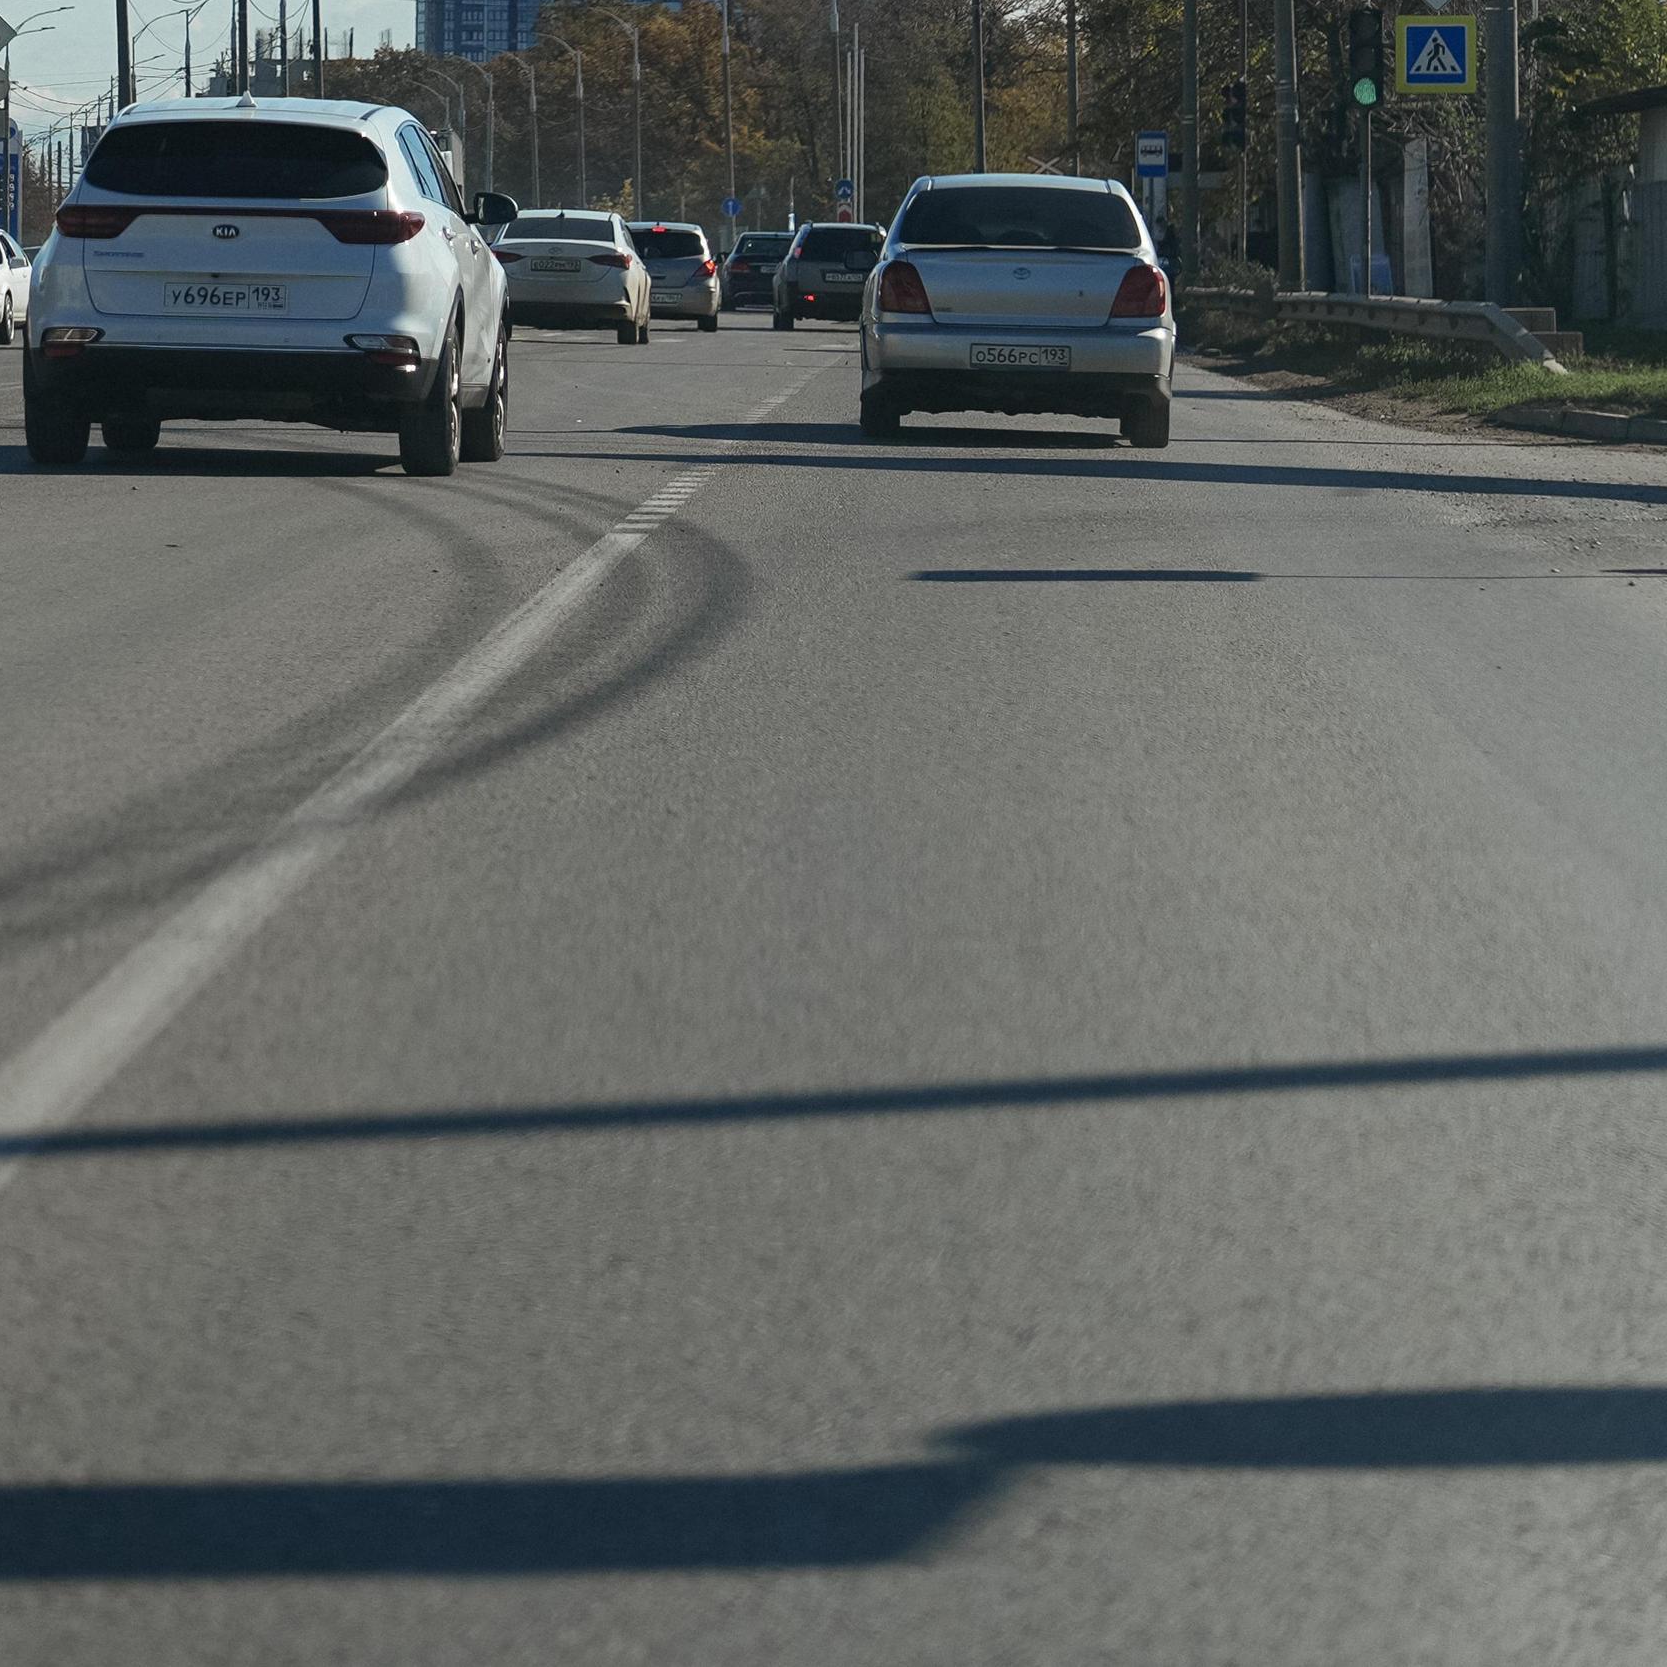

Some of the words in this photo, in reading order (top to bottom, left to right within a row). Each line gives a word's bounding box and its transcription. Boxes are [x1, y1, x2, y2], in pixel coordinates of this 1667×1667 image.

[216, 227, 237, 237] KIA
[252, 287, 281, 301] 193
[1042, 349, 1066, 360] 193
